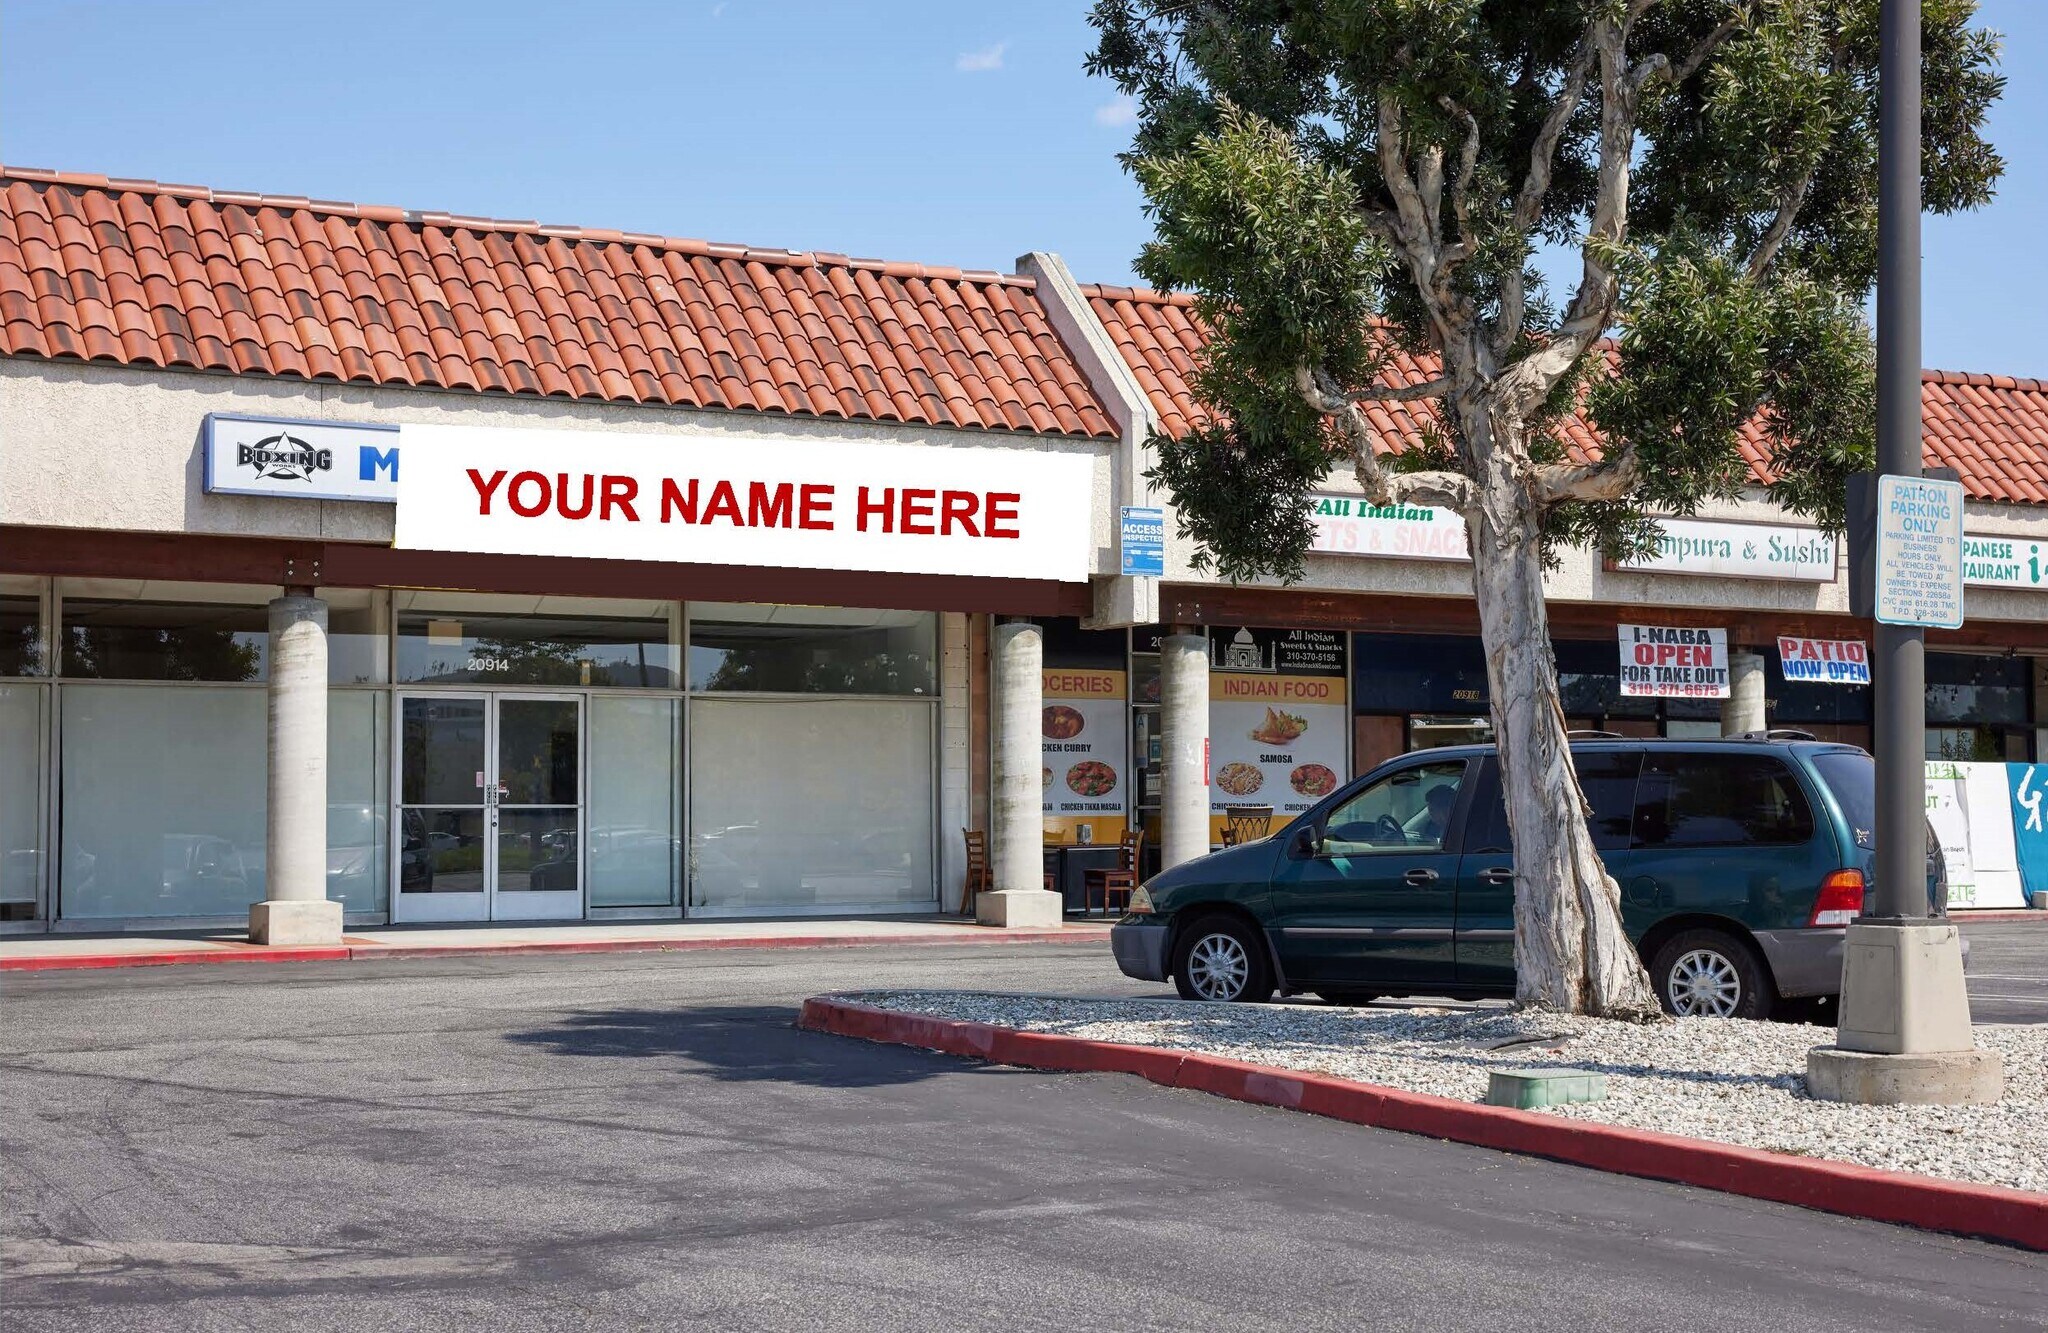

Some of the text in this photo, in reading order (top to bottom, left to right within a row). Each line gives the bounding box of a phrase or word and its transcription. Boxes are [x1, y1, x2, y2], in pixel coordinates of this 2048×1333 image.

[237, 441, 333, 472] BOXING
[1895, 486, 1947, 504] PATRON
[1315, 499, 1434, 521] All Indian
[1891, 501, 1950, 520] PARKING
[1123, 524, 1163, 535] ACCESS
[1903, 518, 1938, 533] ONLY
[1393, 524, 1464, 555] SNAC
[1885, 532, 1915, 541] PARKING
[1918, 534, 1943, 544] LIMITED
[1742, 540, 1757, 560] &
[1768, 535, 1829, 565] Sushi
[1904, 543, 1938, 552] BUSINESS
[1964, 541, 2012, 559] PANESE
[1898, 551, 1921, 560] HOURS
[1886, 559, 1953, 572] ALL VEHICLES WILL
[1909, 571, 1933, 579] TOWED
[1886, 579, 1952, 590] OWNER'S EXPENSE
[1888, 588, 1922, 597] SECTIONS
[1289, 630, 1335, 642] All Indian
[1633, 627, 1712, 645] I-NABA
[1280, 642, 1306, 650] Sweets
[1315, 643, 1343, 651] Snacks
[1780, 640, 1864, 662] PATIO
[1287, 652, 1336, 661] 310-370-5156
[1634, 644, 1713, 667] OPEN
[467, 659, 509, 671] 20914
[1783, 660, 1868, 681] NOW OPEN
[1621, 666, 1726, 684] FOR TAKE OUT
[1224, 680, 1329, 698] INDIAN FOOD
[1628, 682, 1720, 696] 310-371-6675
[1064, 744, 1091, 752] CURRY
[1260, 754, 1293, 763] SAMOSA
